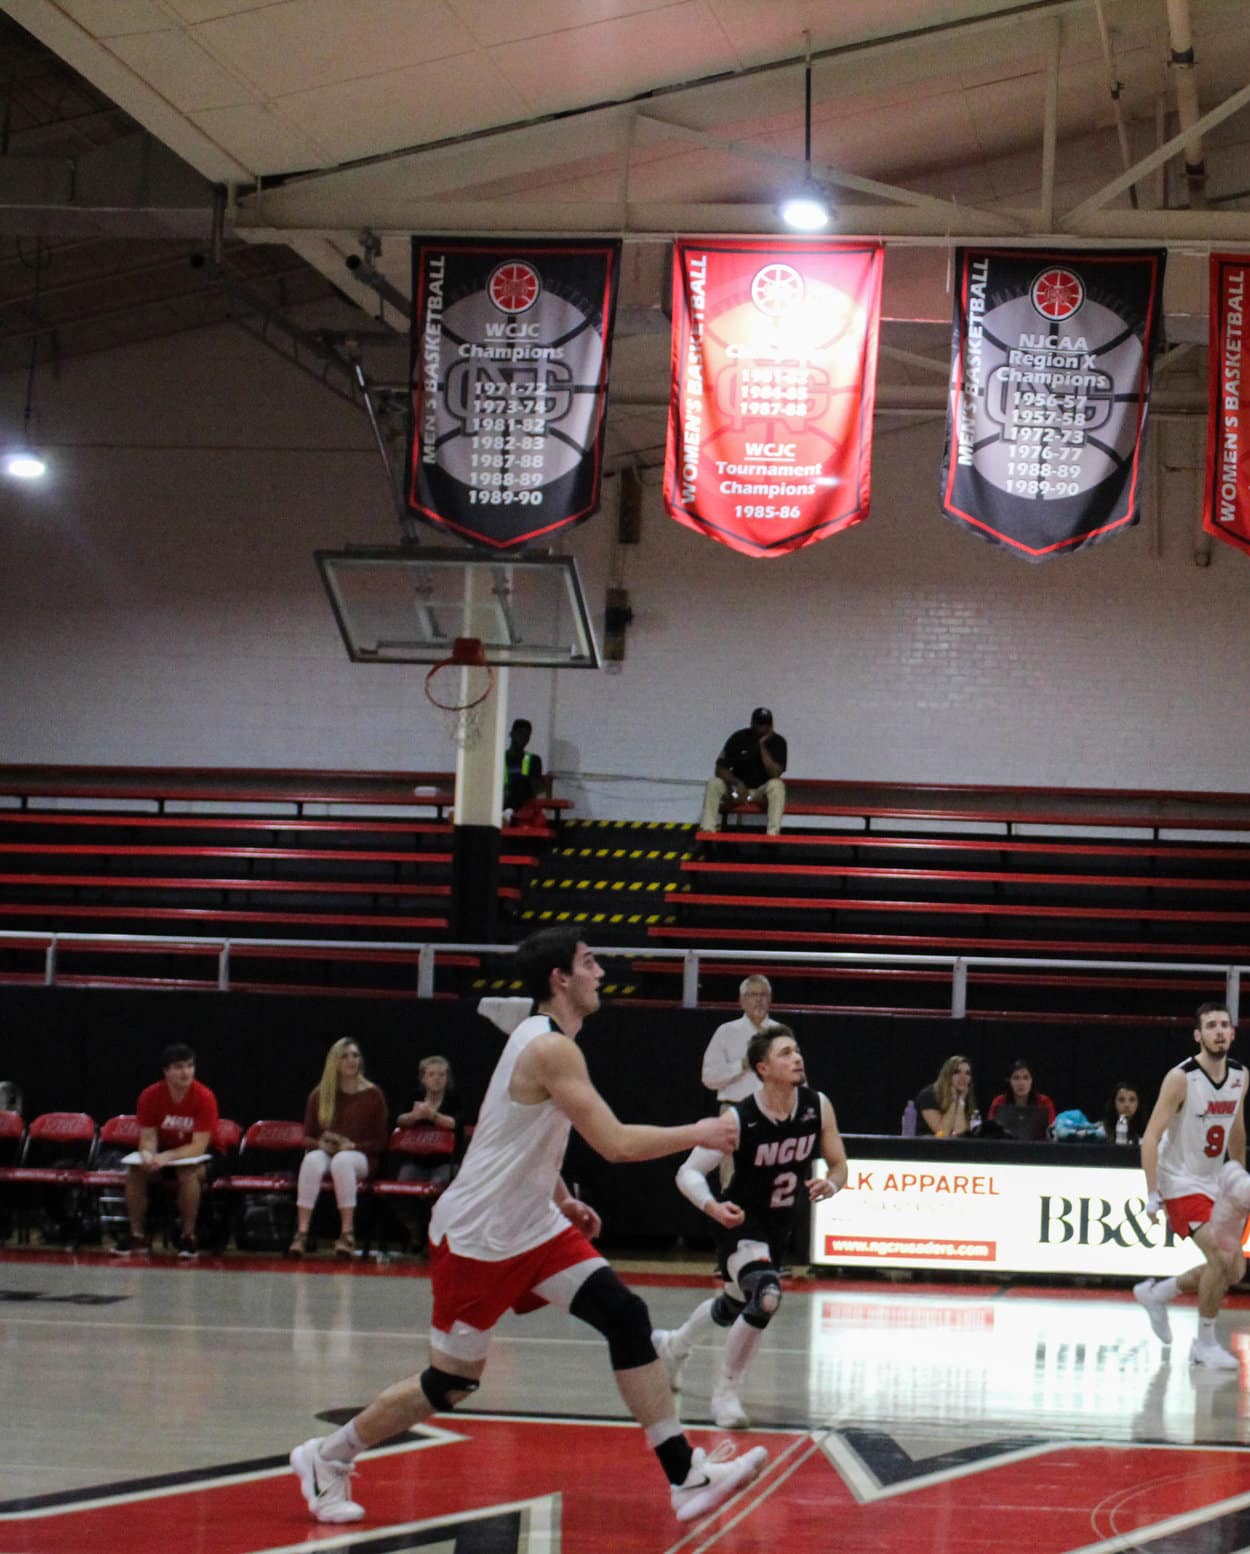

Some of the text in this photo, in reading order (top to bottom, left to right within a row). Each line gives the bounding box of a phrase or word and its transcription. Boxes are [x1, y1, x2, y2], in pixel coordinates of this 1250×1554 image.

[424, 255, 446, 393] BASKETBALL
[485, 322, 540, 338] WCJC
[1018, 333, 1089, 351] NJCAA
[458, 343, 565, 362] Champions
[1008, 350, 1097, 371] Region X
[958, 258, 990, 467] MEN'S BASKETBALL
[680, 254, 708, 504] WOMEN'S BASKETBALL
[995, 366, 1108, 389] Champions
[474, 382, 548, 396] 1971-72
[1219, 270, 1245, 522] WOMEN'S BASKETBALL
[473, 400, 547, 414] 1973-74
[1012, 391, 1088, 407] 1956-57
[1011, 409, 1086, 425] 1957-58
[472, 418, 546, 433] 1981-82
[470, 436, 545, 450] 1982-83
[1009, 427, 1085, 443] 1972-73
[744, 443, 797, 458] WCJC
[1008, 445, 1083, 460] 1976-77
[470, 454, 544, 468] 1987-88
[715, 461, 823, 477] Tournament
[1006, 462, 1082, 478] 1988-89
[469, 472, 544, 486] 1988-89
[1005, 479, 1080, 495] 1989-90
[468, 490, 544, 505] 1989-90
[719, 480, 816, 500] Champions
[735, 505, 801, 519] 1985-86
[1203, 1124, 1226, 1158] 9
[754, 1133, 816, 1167] NGU
[769, 1171, 798, 1209] 2
[883, 1172, 1000, 1196] APPAREL
